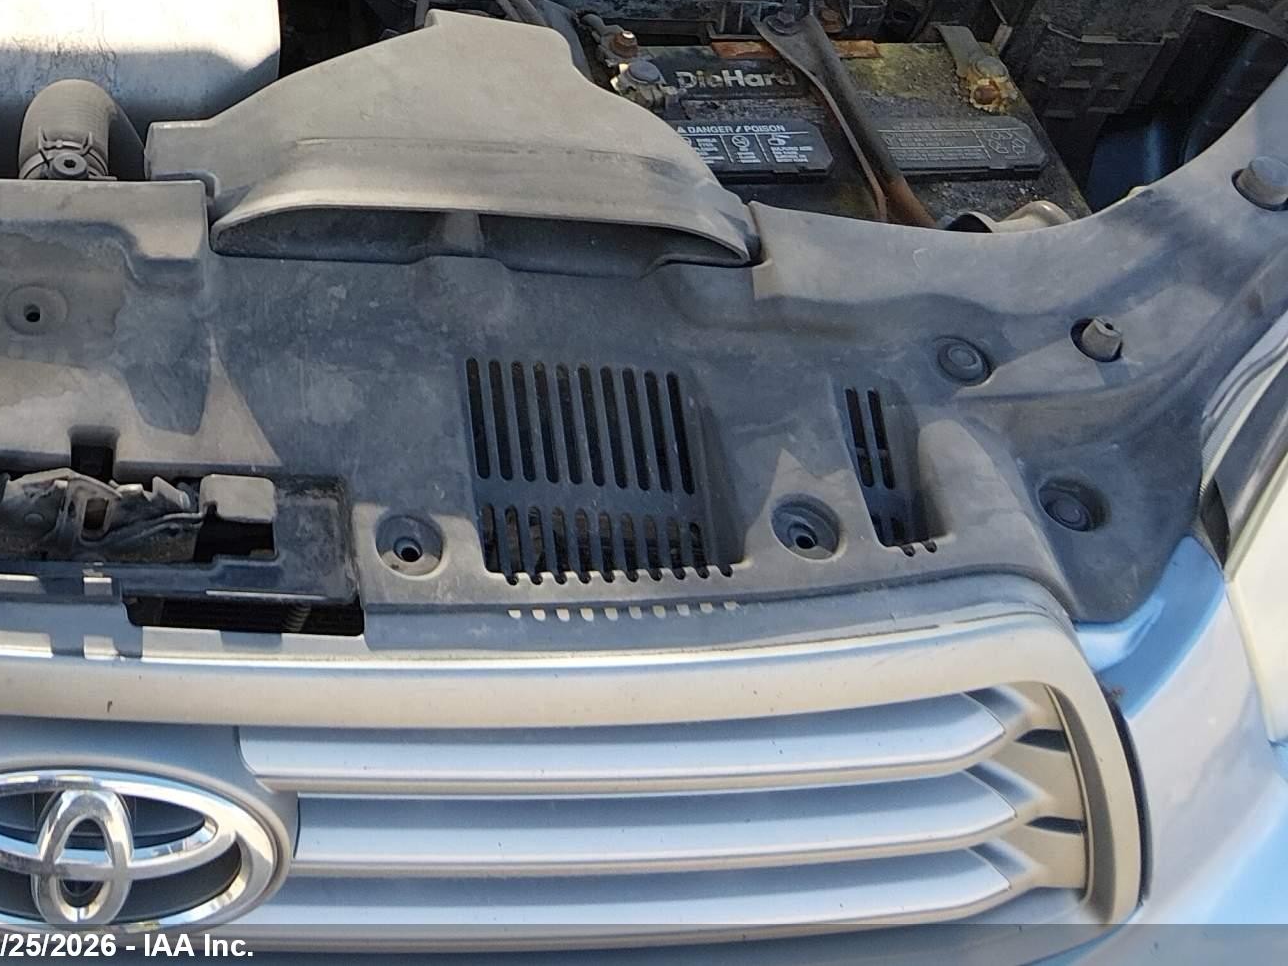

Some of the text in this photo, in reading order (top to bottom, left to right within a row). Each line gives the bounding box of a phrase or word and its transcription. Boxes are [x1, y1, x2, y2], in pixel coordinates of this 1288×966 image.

[675, 69, 796, 88] DieHard
[687, 126, 734, 134] DANGER
[744, 125, 786, 133] POISON
